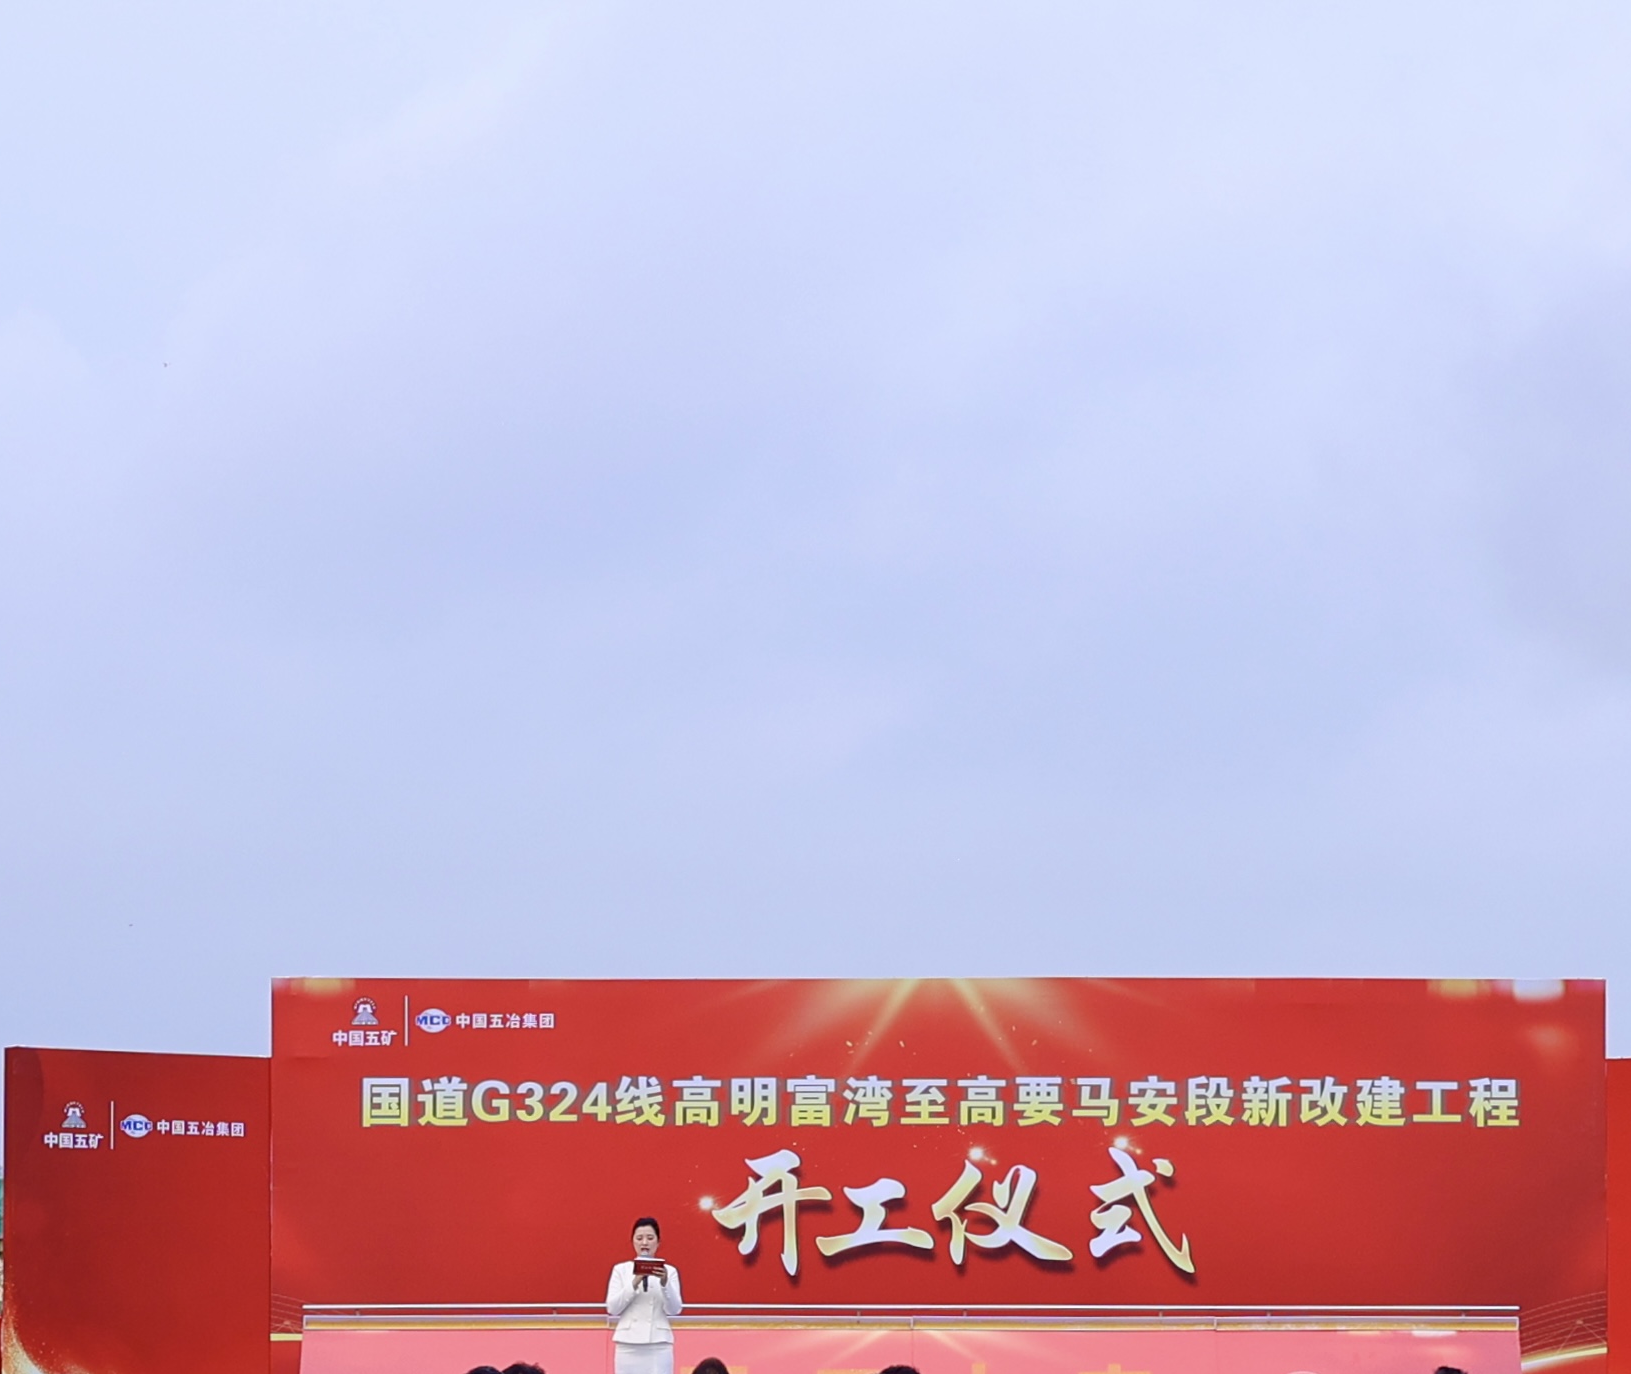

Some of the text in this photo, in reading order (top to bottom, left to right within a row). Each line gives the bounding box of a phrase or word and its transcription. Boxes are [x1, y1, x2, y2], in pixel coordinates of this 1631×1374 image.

[455, 1012, 555, 1029] 中国五冶集团
[332, 1029, 397, 1047] 中国五矿
[360, 1074, 1520, 1129] 国道G324线高明富湾至高要马安段新改建工程
[157, 1119, 245, 1137] 中国五冶集团
[43, 1132, 104, 1149] 中国五矿
[712, 1145, 1197, 1277] 开工仪式
